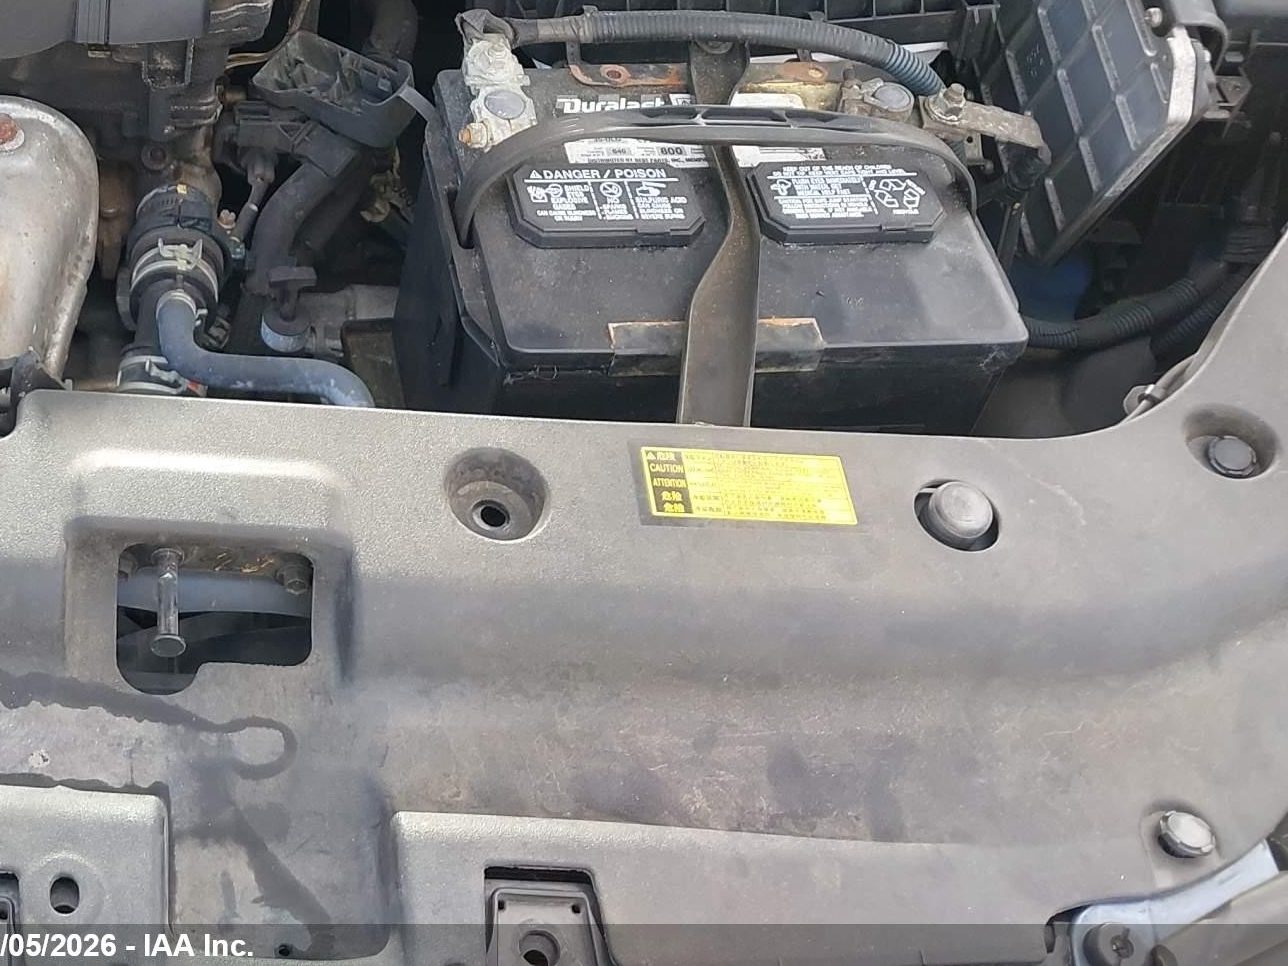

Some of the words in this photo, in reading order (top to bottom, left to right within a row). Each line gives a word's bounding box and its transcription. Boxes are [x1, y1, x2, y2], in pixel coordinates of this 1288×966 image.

[543, 170, 601, 179] DANGER
[603, 169, 611, 179] /
[614, 169, 667, 179] POISON
[650, 463, 684, 473] CAUTION
[653, 477, 687, 488] ATTENTION
